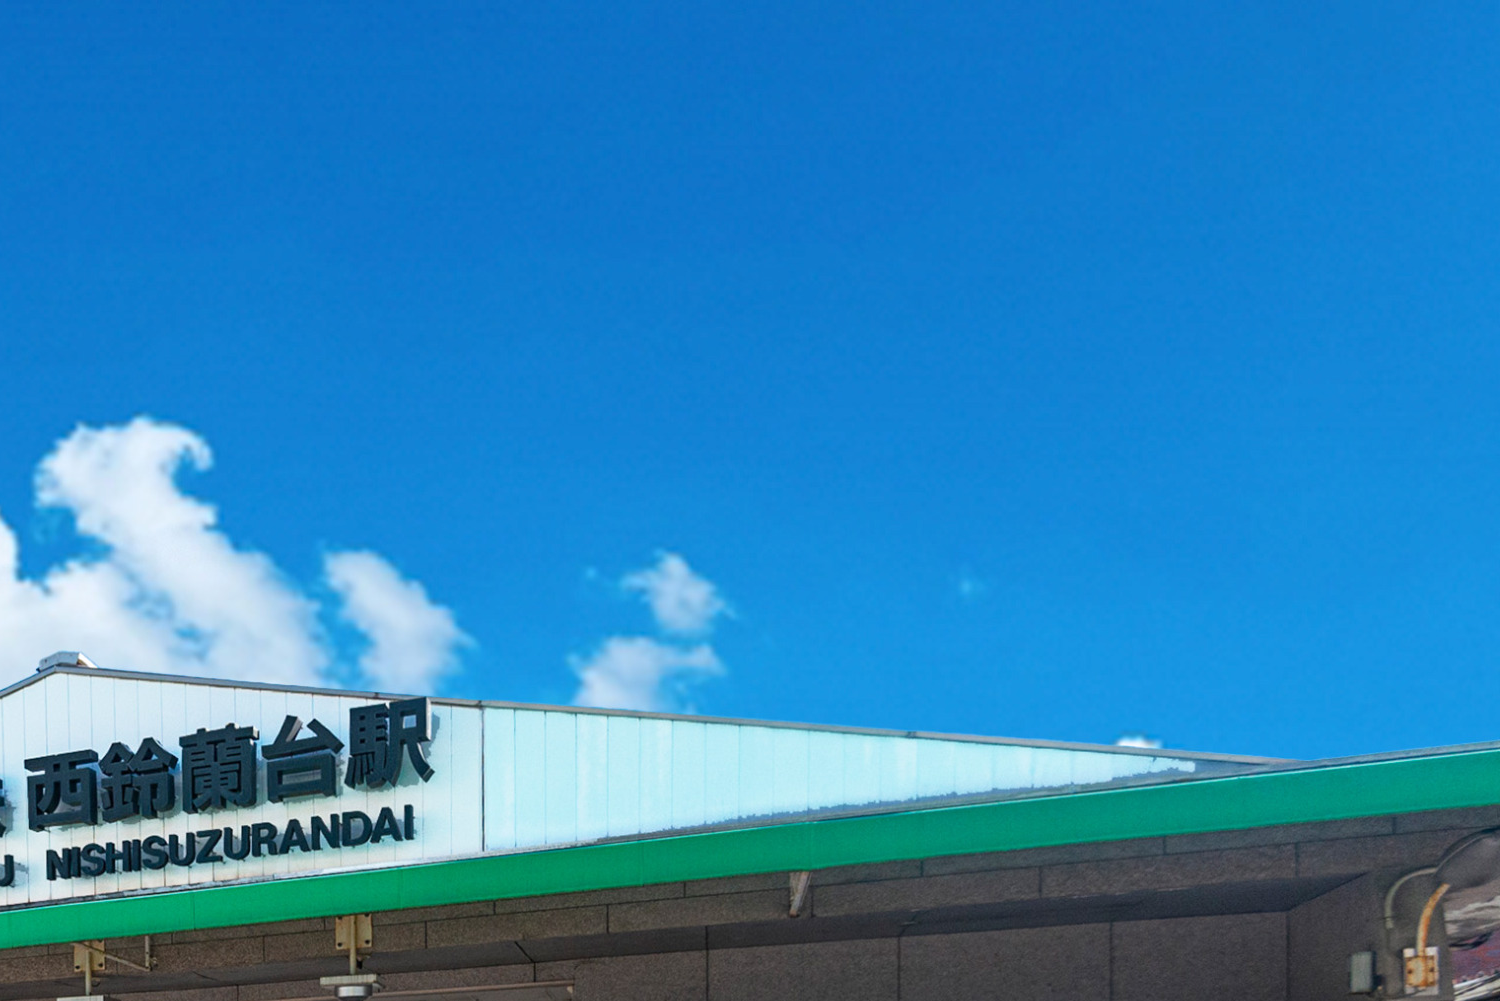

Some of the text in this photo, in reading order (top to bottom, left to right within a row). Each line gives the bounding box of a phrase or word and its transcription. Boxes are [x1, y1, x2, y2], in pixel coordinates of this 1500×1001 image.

[23, 697, 436, 832] 西鈴蘭台駅
[45, 803, 415, 881] NISHISUZURANDAI
